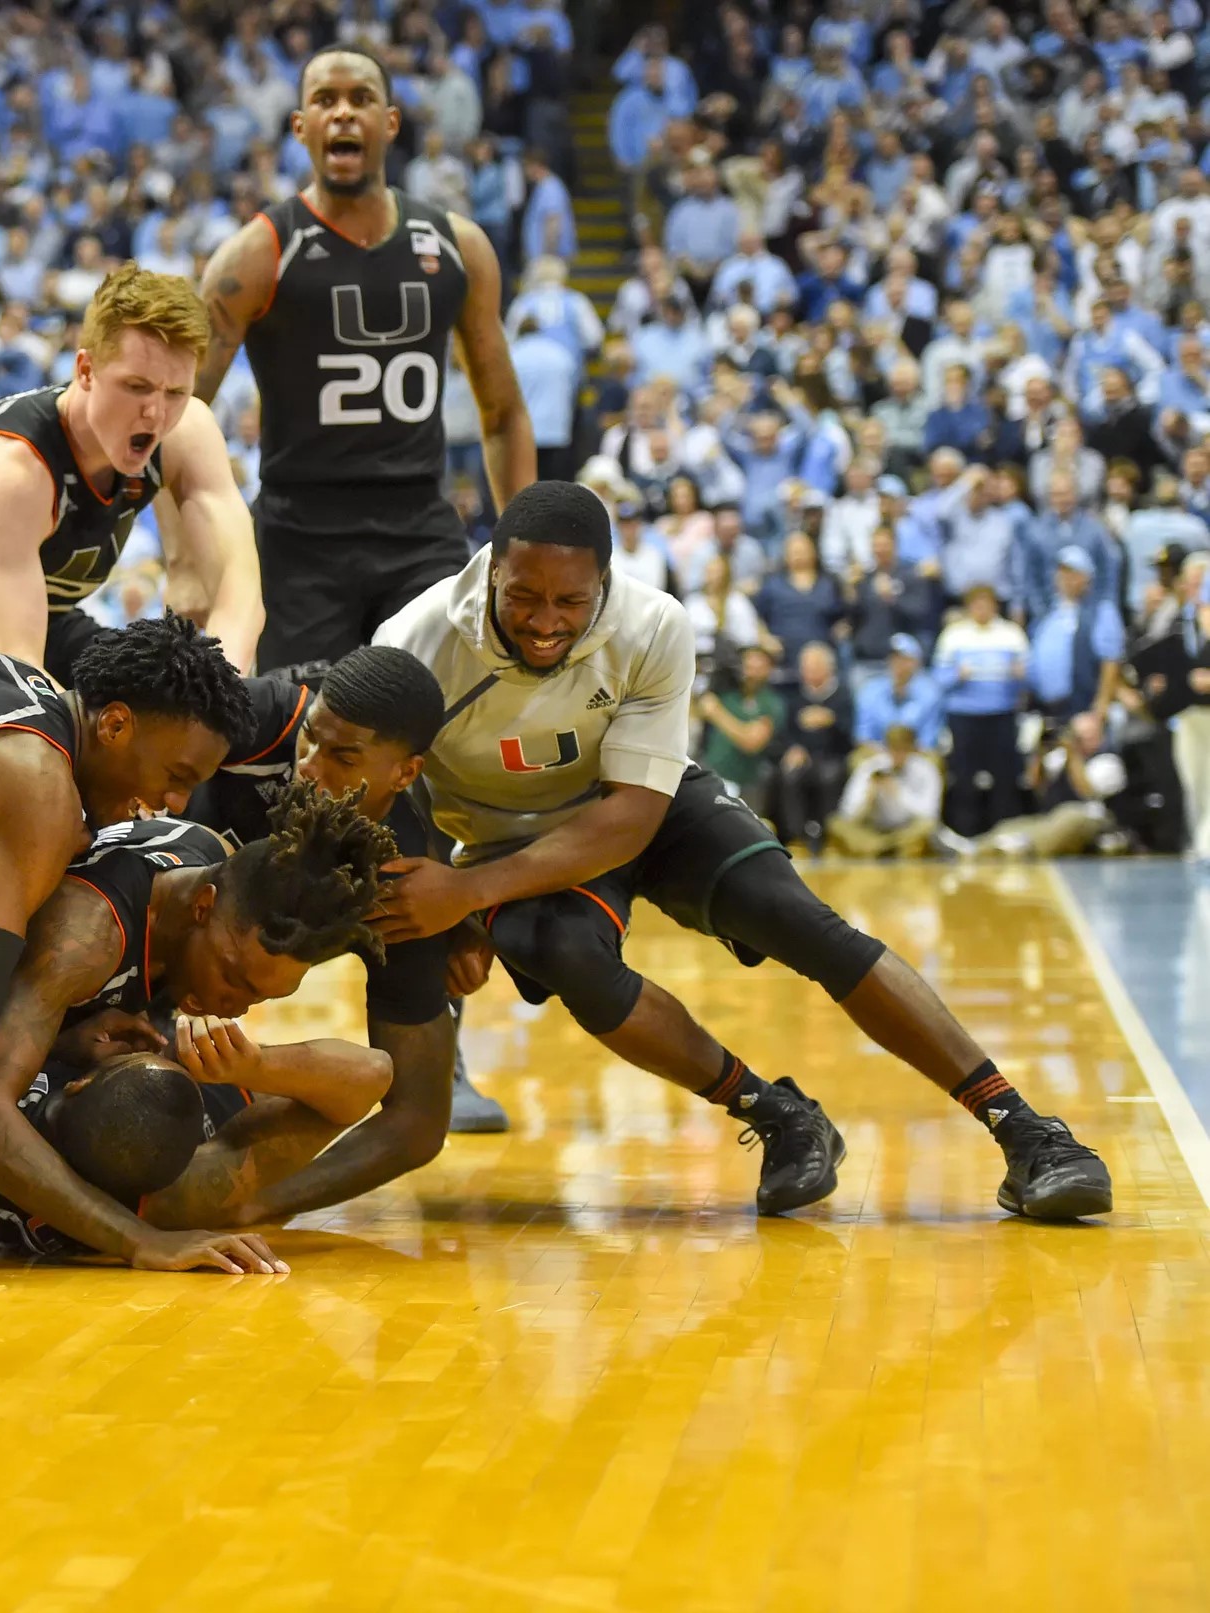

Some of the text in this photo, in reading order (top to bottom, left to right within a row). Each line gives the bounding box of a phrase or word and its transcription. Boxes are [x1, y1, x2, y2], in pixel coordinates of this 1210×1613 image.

[330, 281, 432, 347] U
[317, 351, 438, 426] 20
[586, 699, 616, 710] adidas
[499, 727, 581, 774] U
